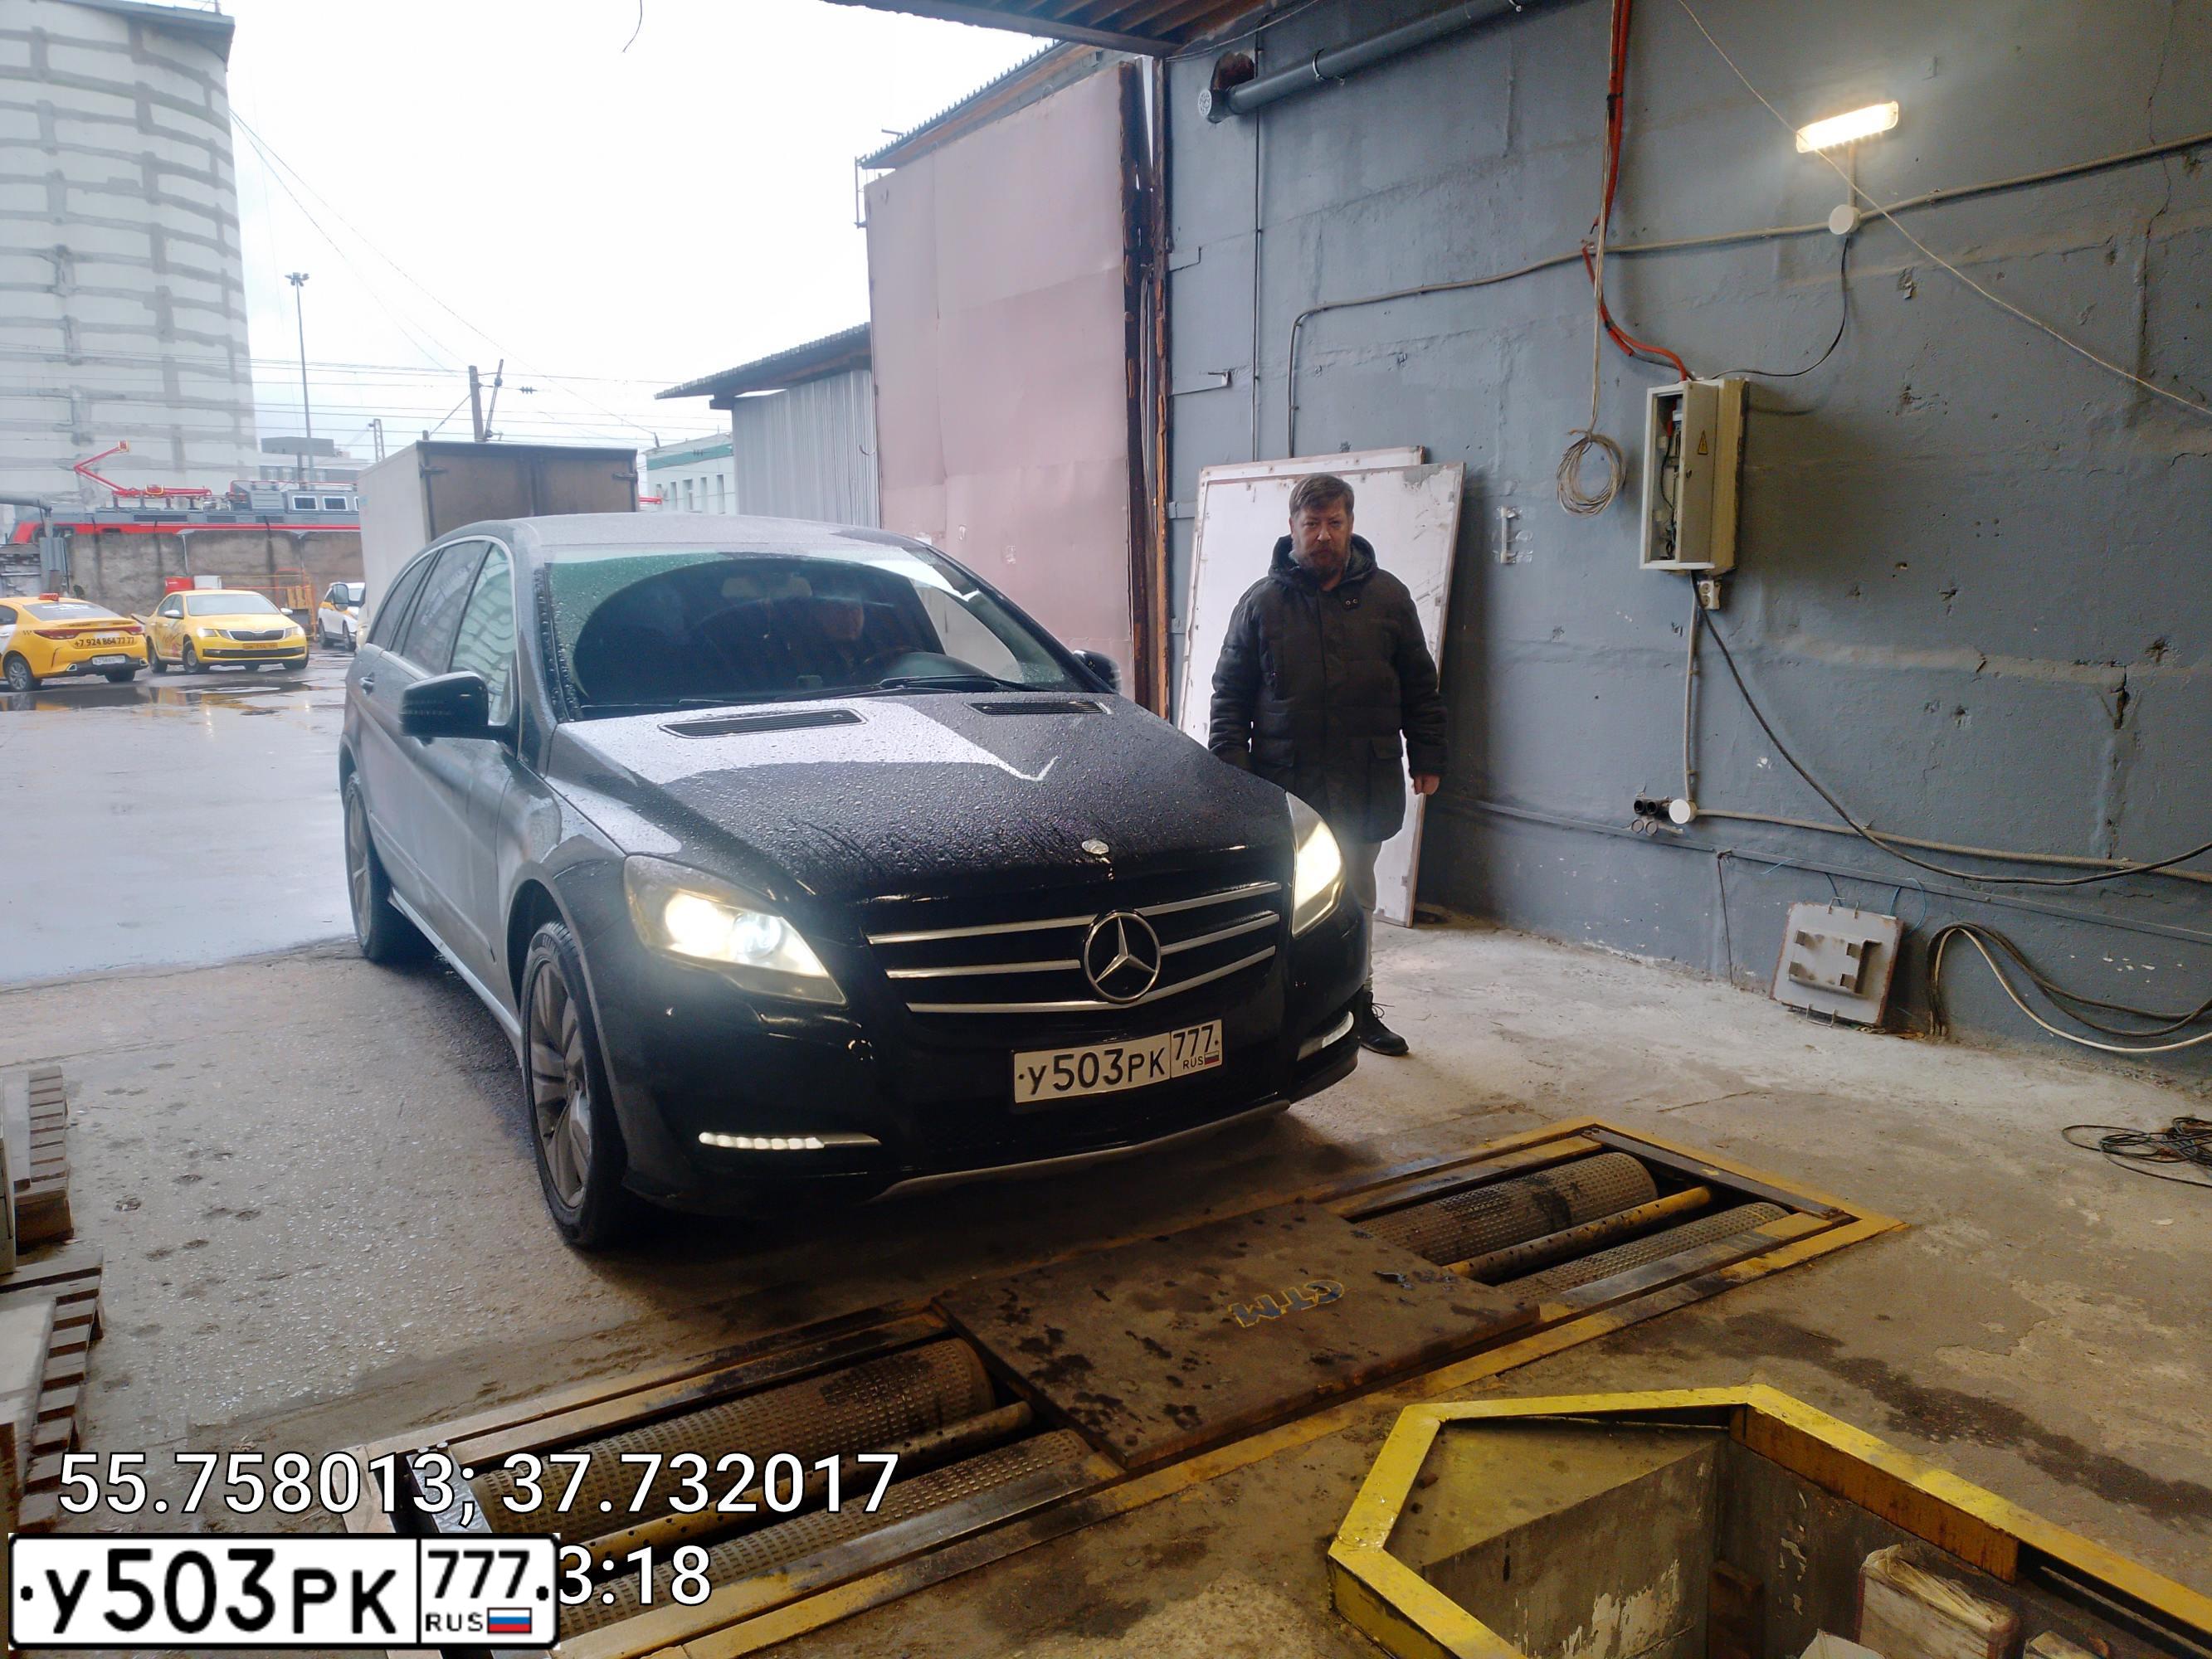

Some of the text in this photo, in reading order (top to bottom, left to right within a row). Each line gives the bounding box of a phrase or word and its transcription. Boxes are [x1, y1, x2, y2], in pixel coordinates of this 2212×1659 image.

[86, 638, 101, 646] 924
[1027, 1024, 1214, 1095] У503РК 777
[1182, 1055, 1204, 1070] RUS
